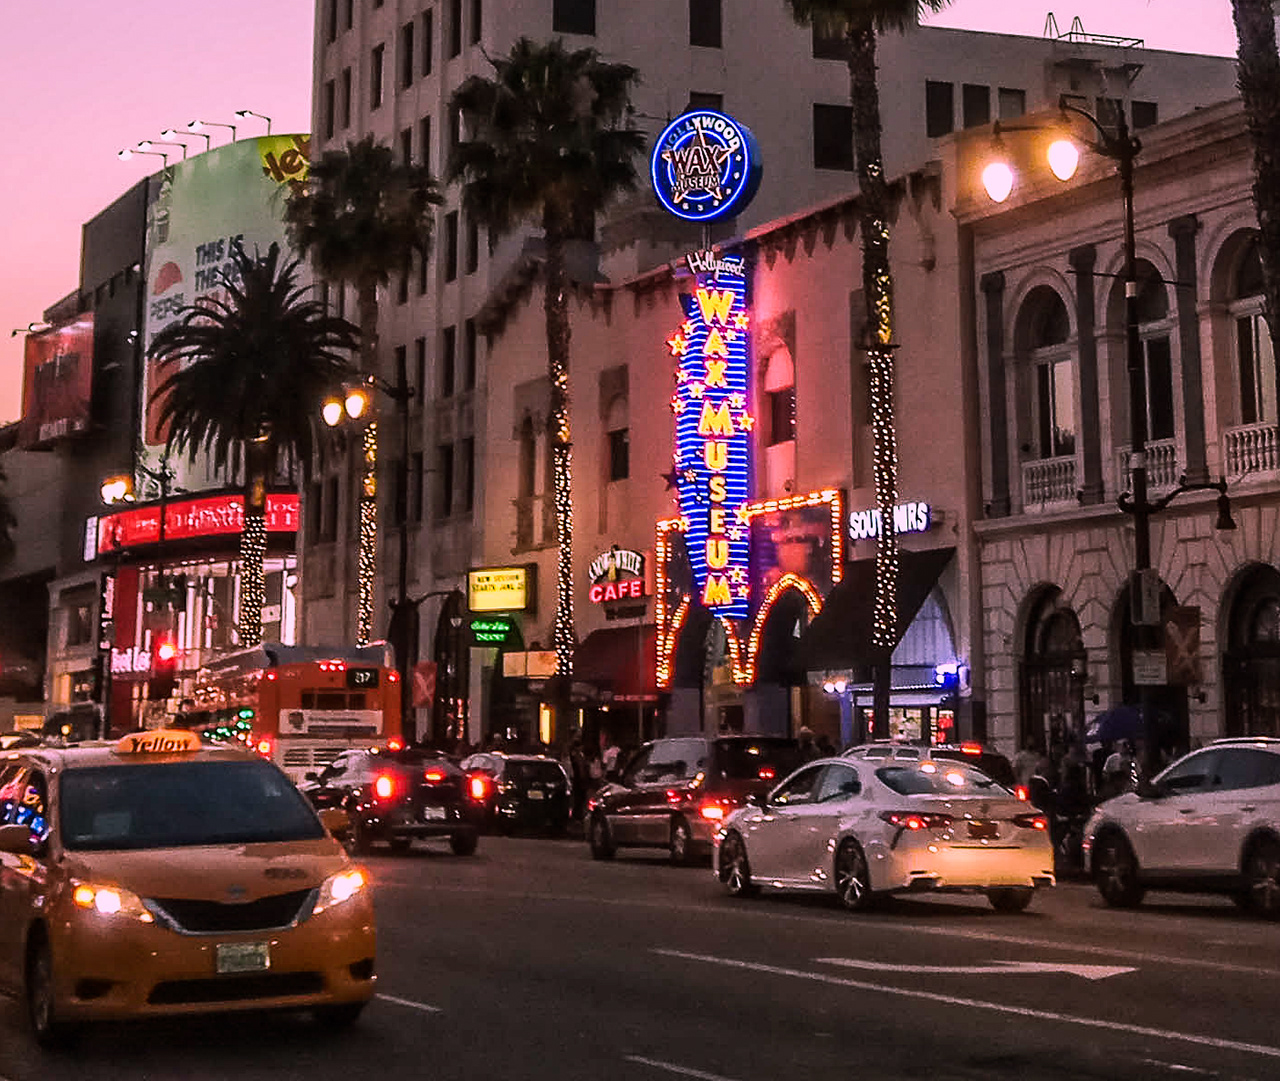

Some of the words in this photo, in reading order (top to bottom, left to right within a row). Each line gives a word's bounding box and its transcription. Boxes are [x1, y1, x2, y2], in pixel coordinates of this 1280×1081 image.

[664, 115, 741, 152] HOLLYWOOD
[668, 145, 722, 174] WAX
[671, 173, 722, 191] MUSEUM
[686, 250, 745, 281] Hollywood
[696, 289, 735, 387] WAX
[697, 399, 735, 607] MUSEUM
[589, 580, 642, 603] CAFE
[131, 737, 191, 754] Yellow
